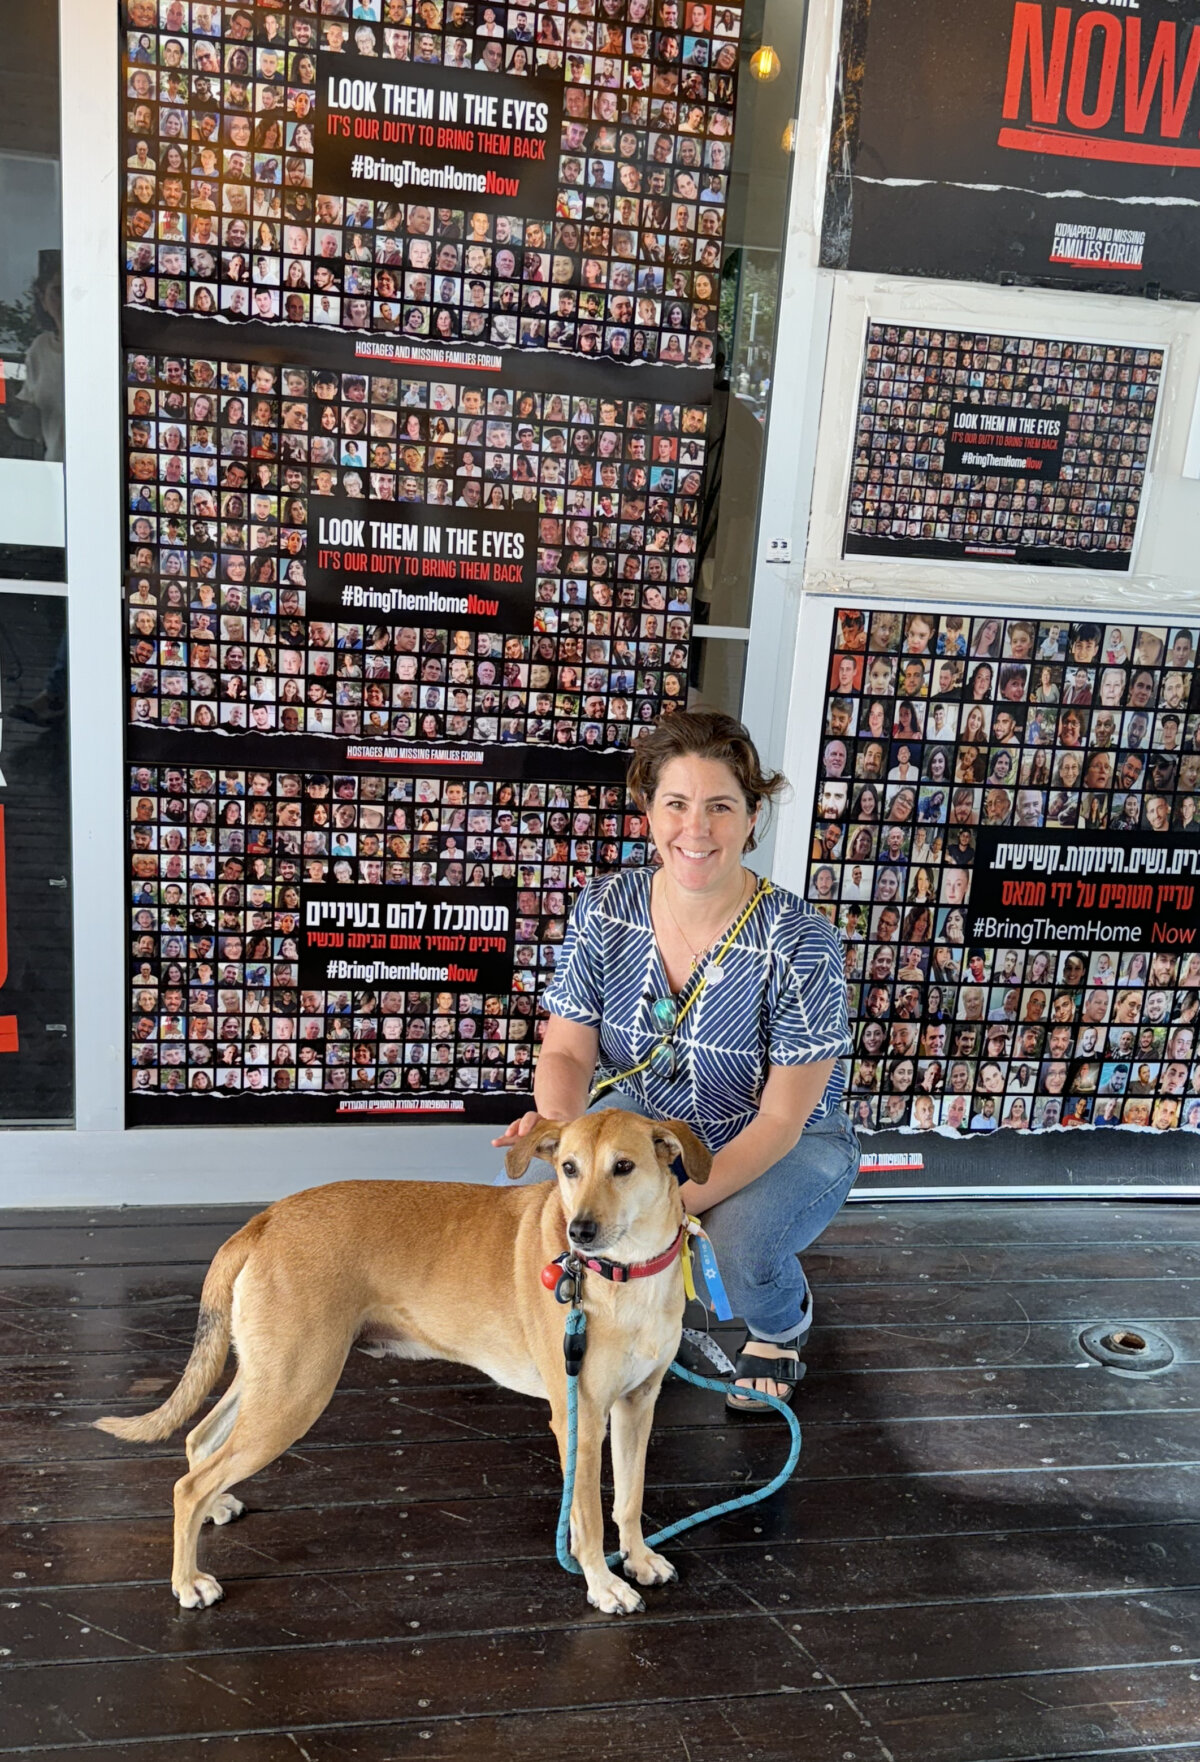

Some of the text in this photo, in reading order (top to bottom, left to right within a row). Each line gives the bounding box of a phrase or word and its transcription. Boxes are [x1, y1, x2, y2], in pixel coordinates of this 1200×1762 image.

[1002, 1, 1200, 139] NOW
[328, 76, 548, 133] LOOK THEM IN THE EYES
[327, 114, 546, 160] IT'S OUR DUTY TO BRING THEM BACK
[351, 154, 520, 197] #BringThemHomeNow
[1054, 222, 1145, 244] KIDNAPPED AND MISSING
[1051, 237, 1143, 264] FAMILIES FORUM
[355, 341, 502, 368] HOSTAGES AND MISSING FAMILIES FORUM
[954, 412, 1060, 436] LOOK THEM IN THE EYES
[951, 432, 1059, 450] IT'S OUR DUTY TO BRING THEM BACK
[961, 452, 1043, 470] #BringThemHomeNow
[319, 517, 524, 560] LOOK THEM IN THE EYES
[318, 550, 523, 583] IT'S OUR DUTY TO BRING THEM BACK
[341, 585, 499, 616] #BringThemHomeNow
[347, 746, 484, 762] HOSTAGES AND MISSING FAMILIES FORUM
[1002, 880, 1194, 913] עדיין חטופים על ידי חמאס
[306, 901, 509, 932] תסתכלו להם בעיניים
[307, 931, 507, 953] חייבים להחזיר אותם הביתה עכשיו
[973, 917, 1196, 944] #BringThemHome Now
[326, 960, 478, 983] #BringThemHomeNow
